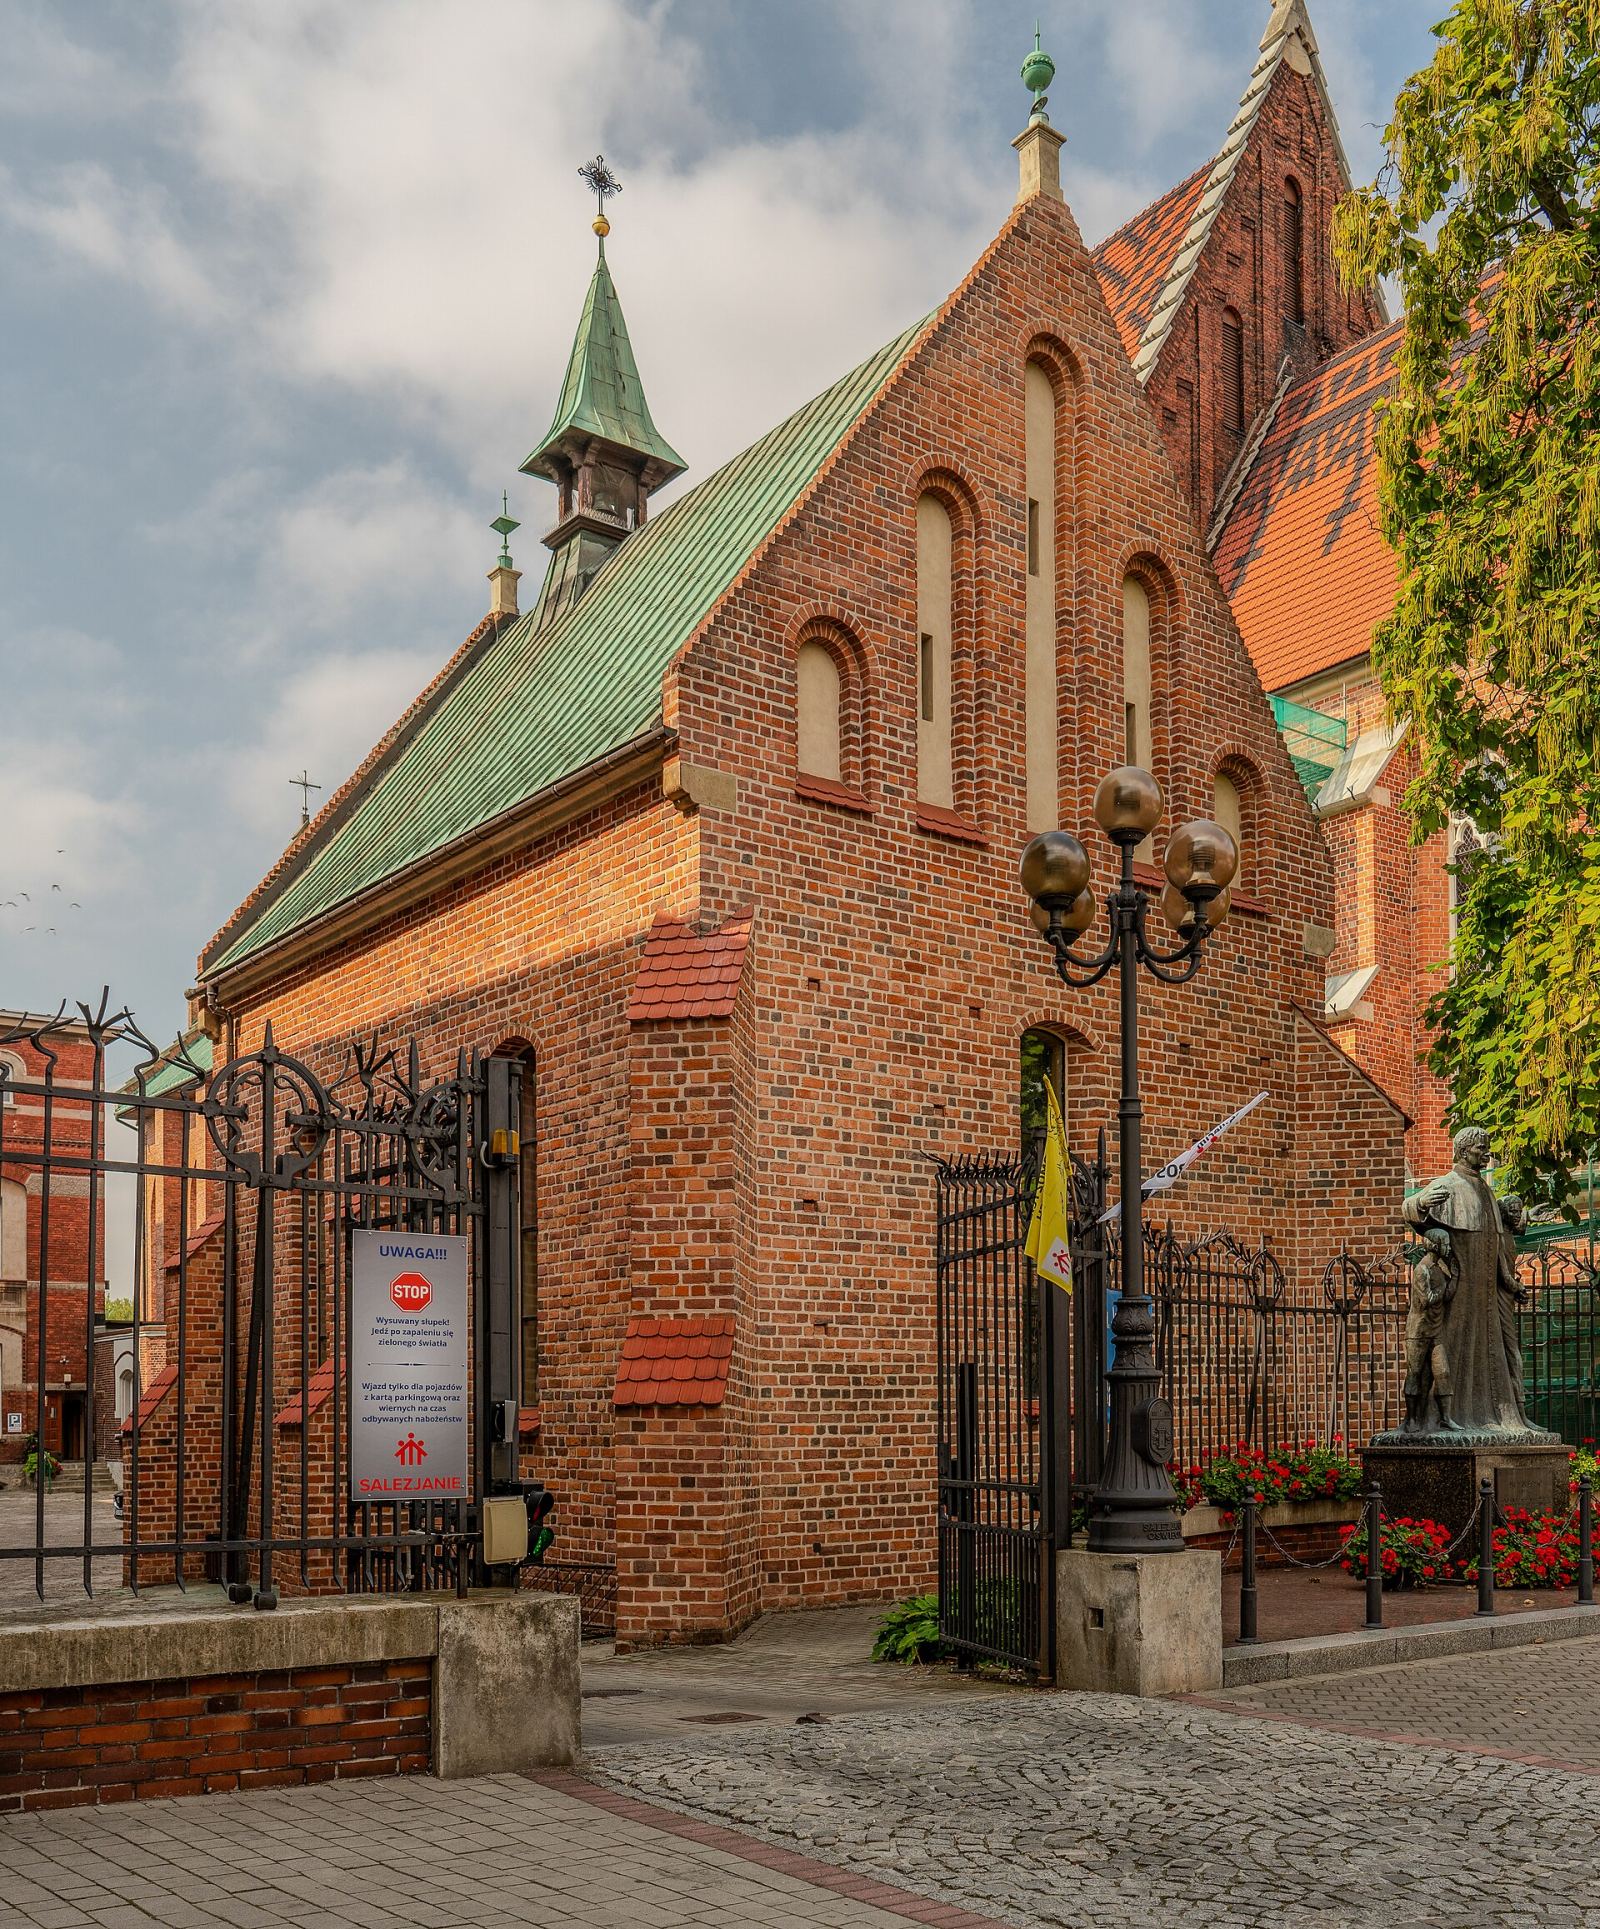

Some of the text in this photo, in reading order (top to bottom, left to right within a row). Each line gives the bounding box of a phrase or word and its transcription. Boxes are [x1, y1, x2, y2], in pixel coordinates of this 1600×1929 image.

[379, 1245, 447, 1260] UWAGA!!!
[394, 1285, 429, 1298] STOP
[376, 1317, 419, 1326] Wysuwany
[402, 1328, 441, 1337] zapaleniu
[378, 1339, 417, 1348] zielonego
[362, 1382, 387, 1392] Wjazd
[388, 1383, 409, 1392] tylko
[425, 1383, 462, 1393] pojazdów
[370, 1394, 393, 1403] kartą
[394, 1394, 442, 1403] parkingową
[379, 1404, 416, 1413] wiernych
[429, 1404, 447, 1412] czas
[11, 1415, 18, 1424] P
[362, 1414, 463, 1424] odbywanych nabożeństw
[360, 1477, 462, 1492] SALEZJANIE
